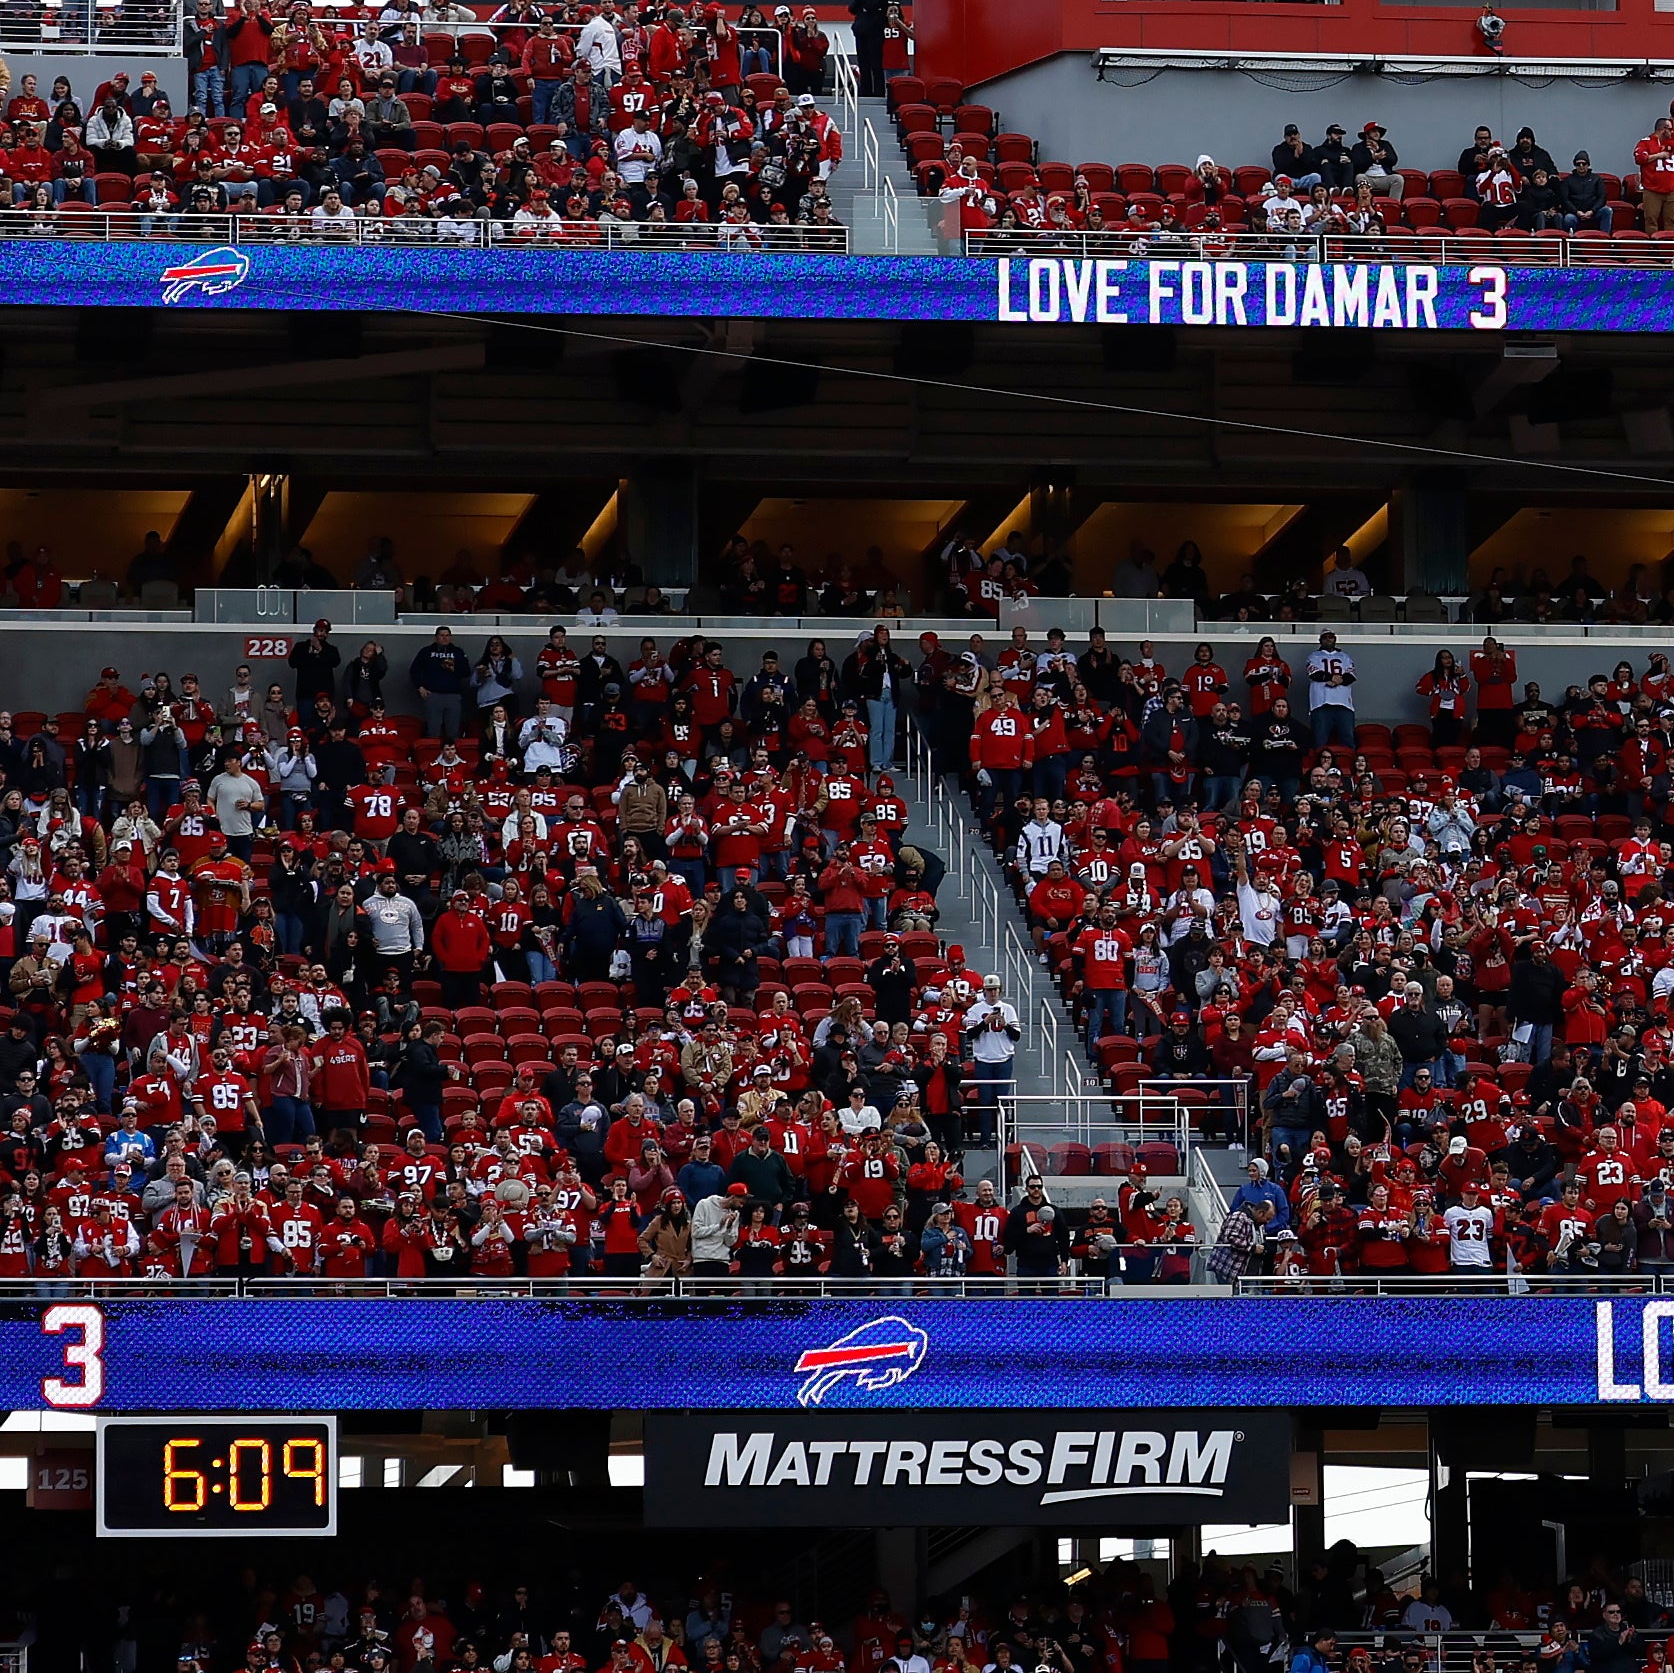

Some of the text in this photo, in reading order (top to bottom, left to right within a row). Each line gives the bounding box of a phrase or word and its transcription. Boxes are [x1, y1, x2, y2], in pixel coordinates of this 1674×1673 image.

[884, 28, 898, 37] 85
[364, 53, 381, 67] 21
[623, 94, 644, 111] 97
[272, 157, 291, 170] 21
[999, 258, 1509, 330] LOVE FOR DAMAR 3
[247, 639, 287, 657] 228
[1322, 658, 1343, 674] 16
[712, 679, 718, 696] 1
[991, 719, 1015, 735] 49
[530, 792, 557, 807] 85
[828, 782, 850, 799] 85
[365, 796, 390, 817] 78
[875, 804, 896, 820] 85
[181, 816, 203, 835] 85
[1040, 835, 1052, 855] 11
[1178, 841, 1202, 859] 85
[1245, 831, 1265, 853] 19
[1341, 850, 1351, 867] 5
[1089, 861, 1107, 881] 10
[63, 890, 87, 907] 44
[170, 890, 179, 908] 7
[500, 913, 519, 932] 10
[1294, 907, 1311, 923] 85
[1094, 939, 1117, 960] 80
[936, 1011, 954, 1022] 97
[231, 1027, 257, 1049] 23
[329, 1055, 356, 1064] 49ERS
[1462, 1099, 1487, 1122] 29
[783, 1132, 798, 1153] 11
[403, 1166, 431, 1184] 97
[864, 1161, 883, 1177] 19
[1597, 1162, 1623, 1184] 23
[68, 1195, 89, 1216] 97
[557, 1192, 580, 1209] 97
[283, 1221, 311, 1247] 85
[974, 1216, 997, 1240] 10
[1457, 1219, 1483, 1240] 23
[791, 1241, 812, 1263] 95
[42, 1301, 104, 1407] 3
[704, 1430, 1235, 1487] MATTRESSFIRM
[38, 1468, 87, 1490] 125
[163, 1439, 326, 1512] 6:09
[294, 1603, 313, 1623] 19
